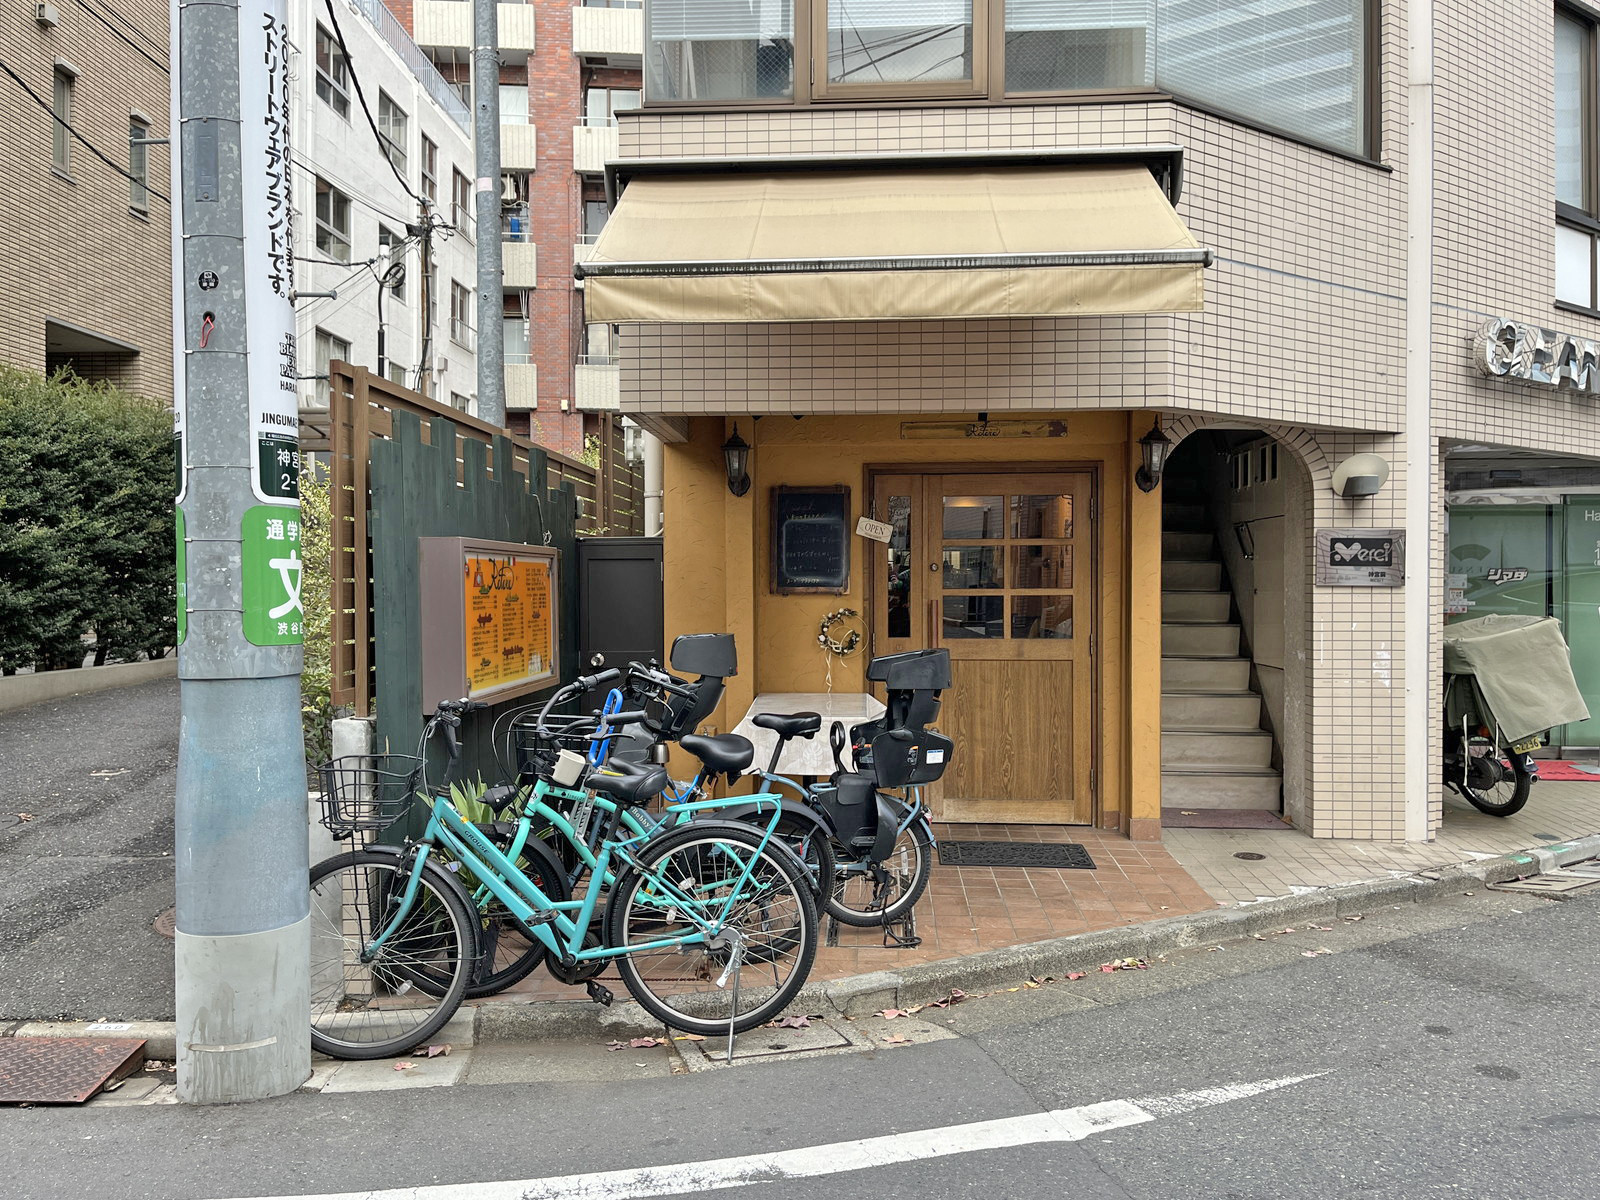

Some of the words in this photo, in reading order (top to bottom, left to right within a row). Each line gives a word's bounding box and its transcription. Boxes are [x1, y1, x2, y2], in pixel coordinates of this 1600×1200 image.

[262, 12, 285, 298] ストリートウェアブランドです。
[266, 518, 302, 541] 通学
[864, 522, 885, 536] OPEN
[1487, 568, 1528, 586] シマダ
